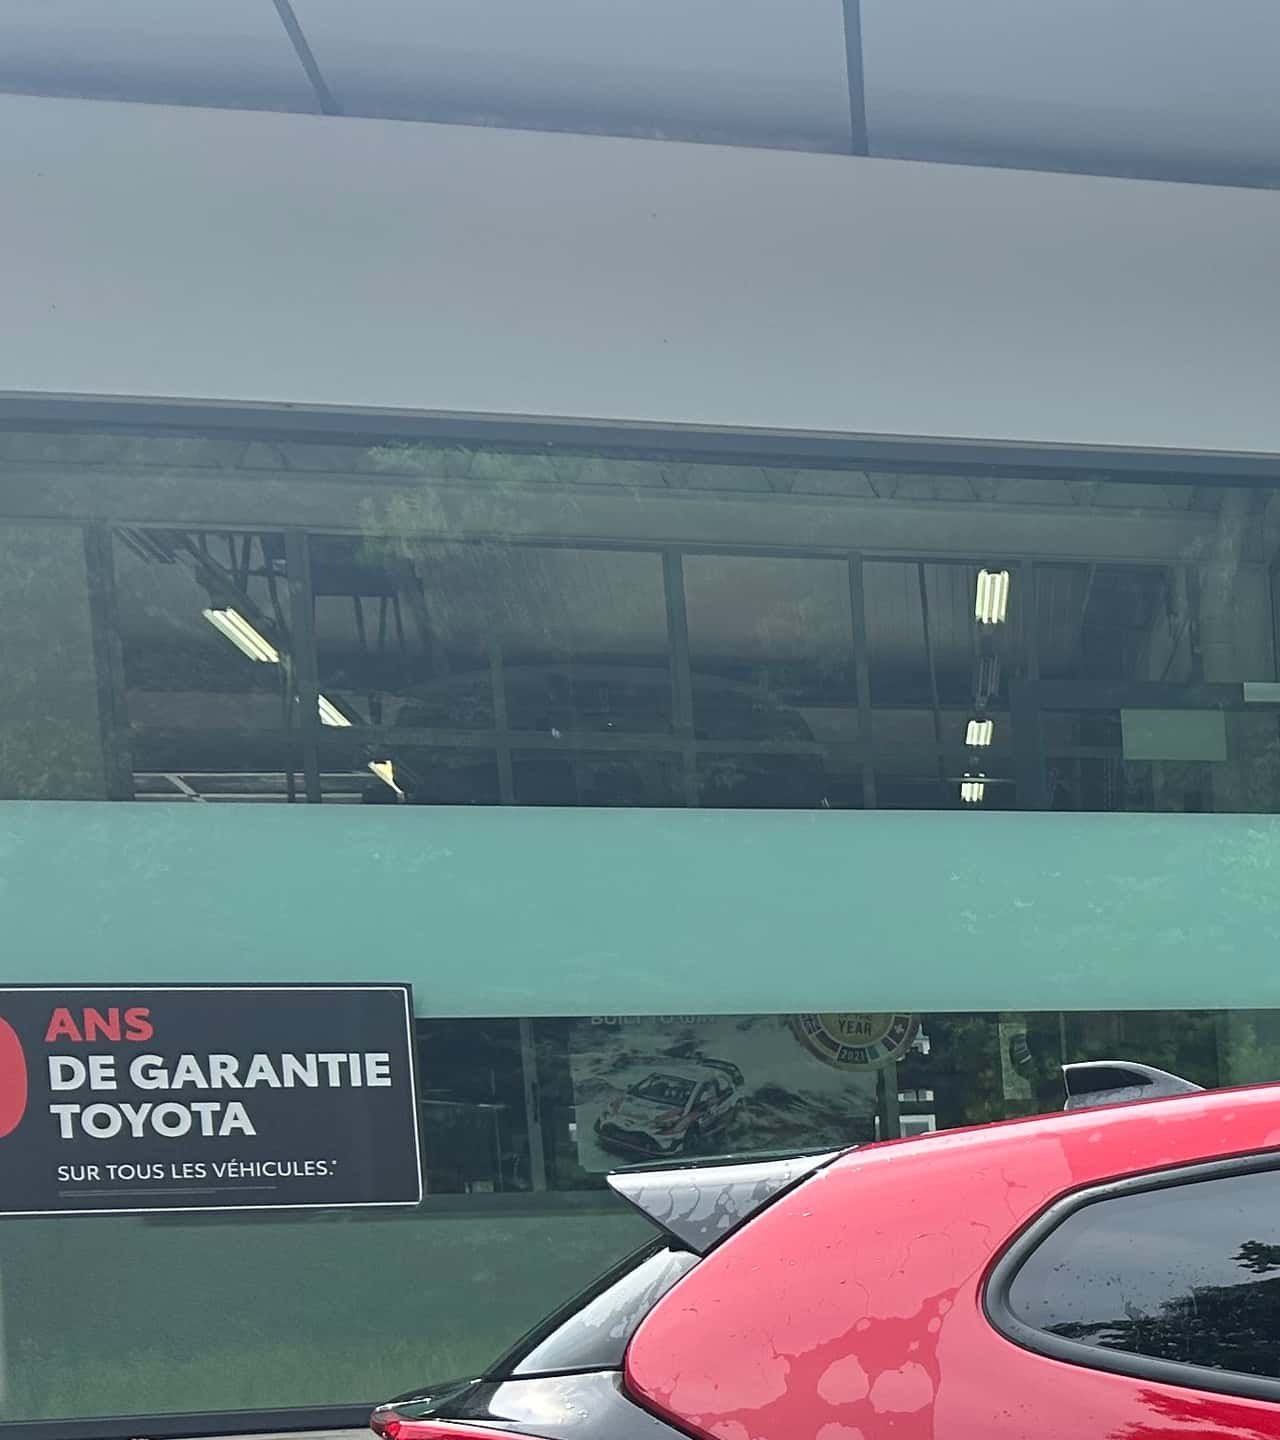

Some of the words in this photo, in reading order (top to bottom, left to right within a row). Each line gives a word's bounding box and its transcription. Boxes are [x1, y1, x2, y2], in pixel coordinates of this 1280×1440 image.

[45, 1006, 154, 1042] ANS
[838, 1019, 872, 1036] YEAR
[840, 1049, 866, 1061] 2021
[48, 1054, 117, 1091] DE
[129, 1052, 393, 1089] GARANTIE
[49, 1101, 257, 1139] TOYOTA
[57, 1164, 101, 1181] SUR
[106, 1163, 165, 1180] TOUS
[171, 1162, 207, 1179] LES
